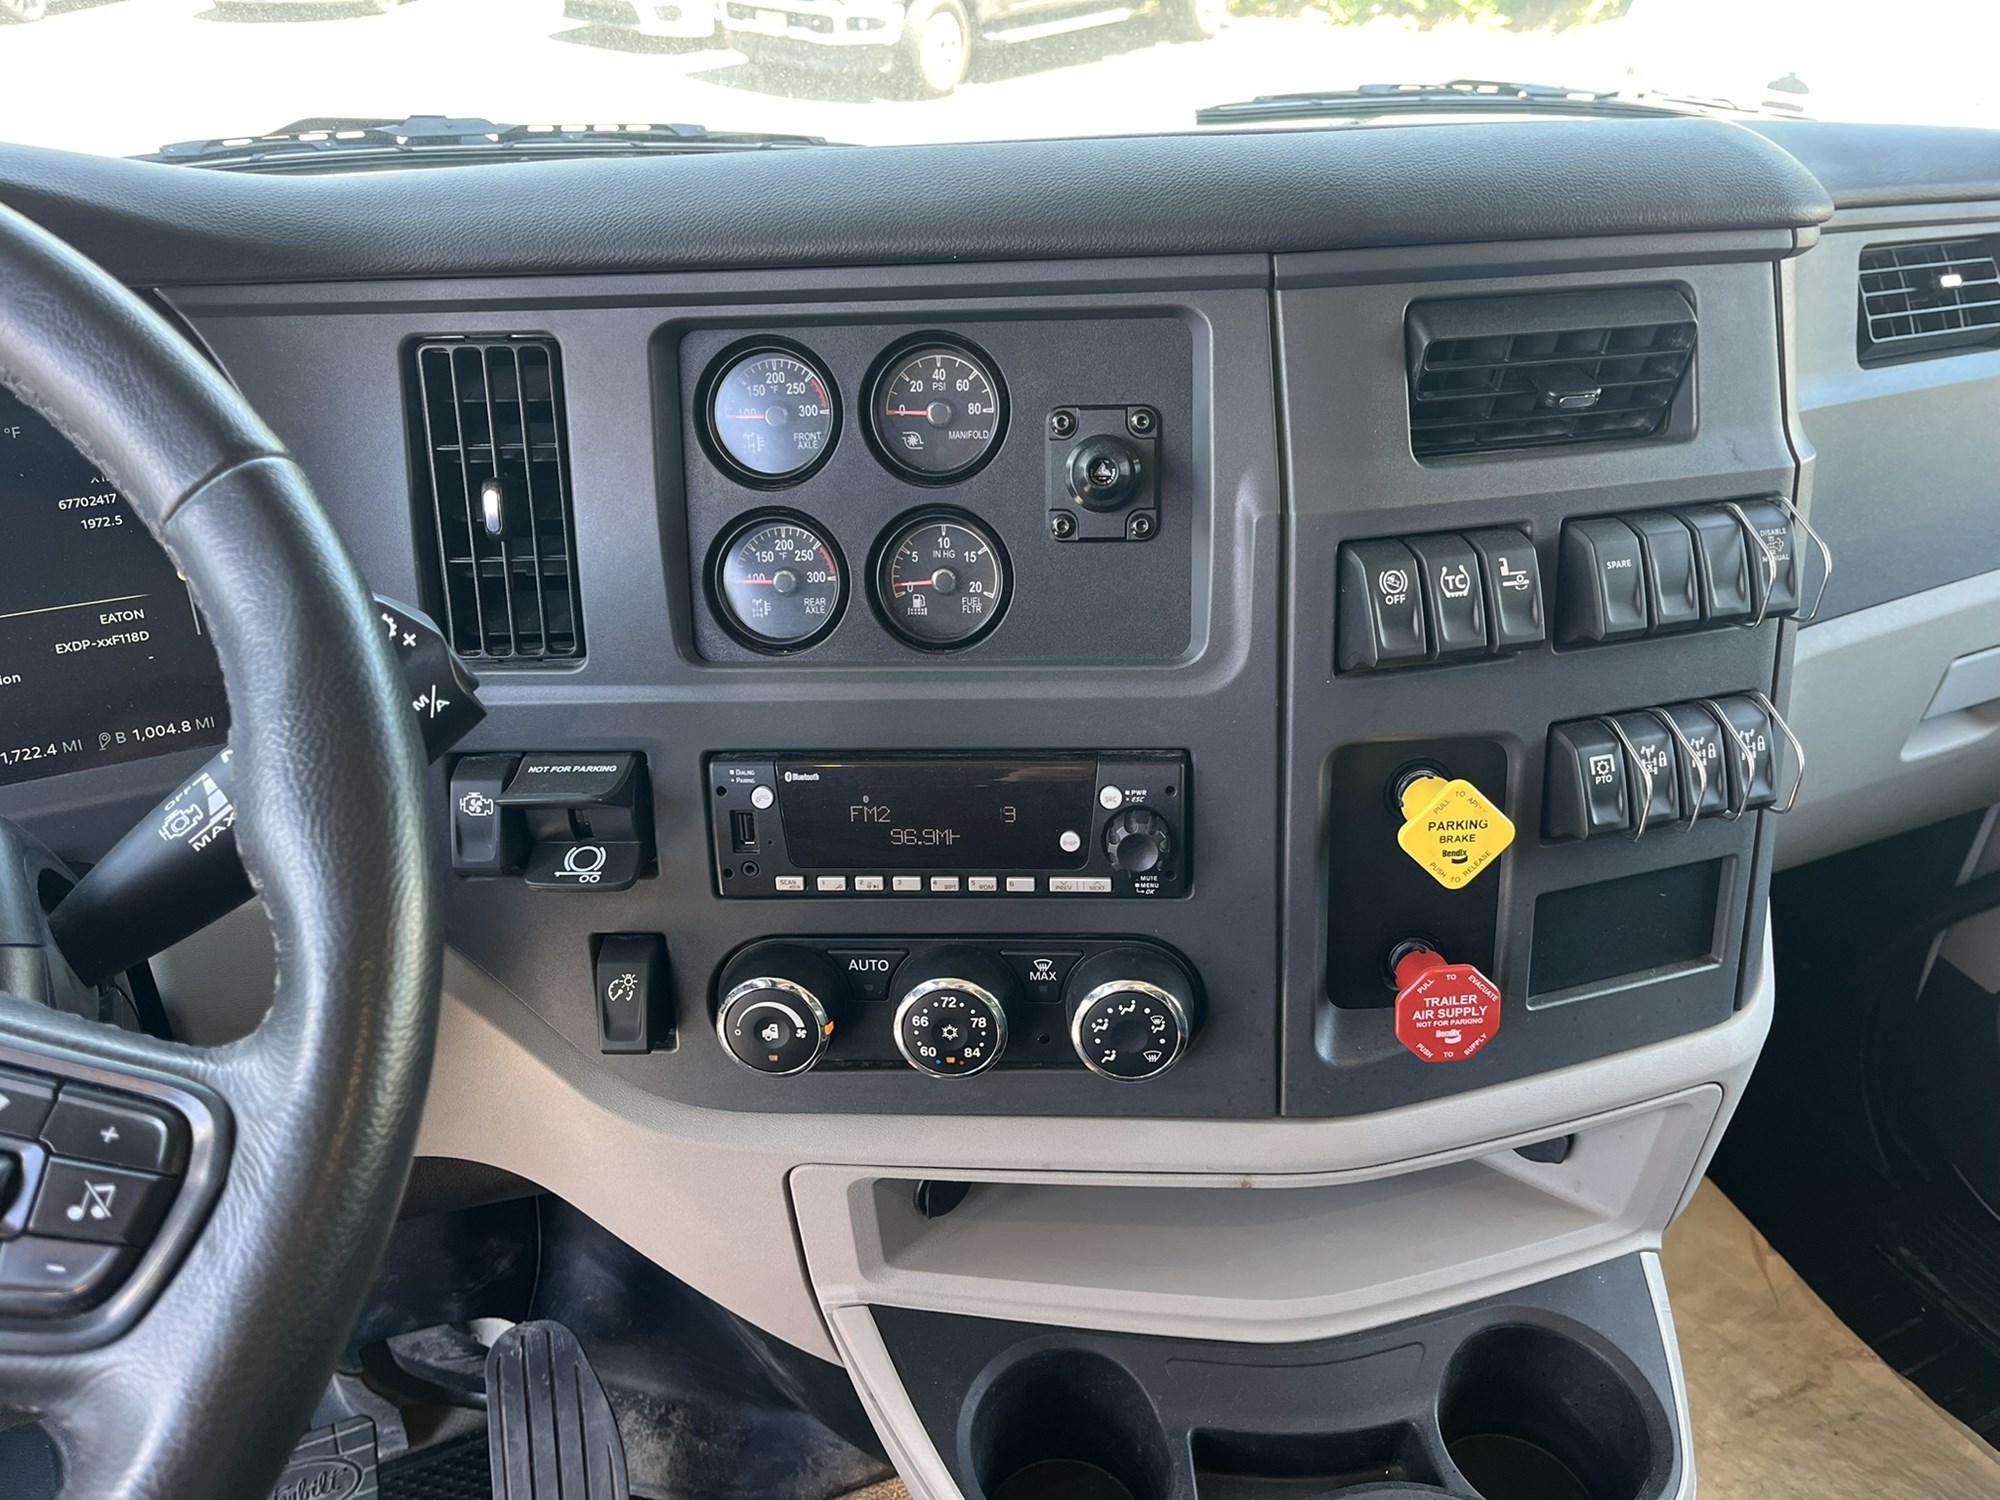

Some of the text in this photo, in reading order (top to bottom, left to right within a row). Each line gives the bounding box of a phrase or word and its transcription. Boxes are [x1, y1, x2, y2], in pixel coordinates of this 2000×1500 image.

[766, 372, 785, 384] 200
[932, 369, 945, 380] 40
[747, 385, 765, 396] 150
[786, 383, 805, 394] 250
[910, 381, 923, 392] 20
[933, 382, 946, 391] PSI
[956, 380, 969, 391] 60
[799, 405, 818, 416] 300
[968, 403, 980, 414] 80
[4, 426, 20, 438] °F
[794, 432, 821, 440] FRONT
[949, 430, 988, 439] MANIFOLD
[798, 441, 818, 449] AXLE
[58, 493, 116, 510] 67702417
[81, 515, 122, 529] 1972.5
[775, 539, 793, 550] 200
[938, 537, 950, 548] 10
[756, 551, 774, 562] 150
[795, 550, 813, 561] 250
[912, 551, 918, 562] 5
[933, 550, 955, 558] IN HG
[964, 551, 976, 562] 15
[1762, 554, 1790, 562] MNUAL
[1606, 559, 1632, 570] SPARE
[807, 571, 826, 583] 300
[1445, 574, 1466, 589] TC
[969, 581, 982, 592] 20
[804, 598, 826, 606] REAR
[962, 597, 982, 605] FUEL
[1385, 594, 1406, 605] OFF
[805, 606, 825, 614] AXLE
[100, 609, 145, 625] EATON
[55, 631, 150, 654] EXDP-xxF118D
[116, 716, 215, 744] B 1,004.8 MI
[0, 739, 82, 765] 1,722.4 MI
[572, 765, 617, 773] PARKING
[793, 772, 819, 781] Bluetooth
[1596, 774, 1612, 784] PTO
[1434, 799, 1451, 815] PULL
[850, 806, 891, 822] FM2
[1428, 820, 1488, 832] PARKING
[192, 812, 235, 852] MAX
[1440, 834, 1476, 843] BRAKE
[1442, 849, 1467, 857] Bendix
[1430, 862, 1447, 878] PUSH
[1463, 850, 1492, 876] RELEASE
[849, 960, 889, 971] AUTO
[1030, 972, 1056, 981] MAX
[1417, 979, 1435, 994] PULL
[1468, 975, 1498, 1002] EVACUATE
[941, 997, 956, 1008] 72
[1424, 995, 1477, 1007] TRAILER
[1412, 1006, 1488, 1020] AIR SUPPLY
[912, 1016, 929, 1027] 66
[971, 1017, 987, 1028] 78
[1416, 1043, 1433, 1058] PUSH
[1464, 1033, 1487, 1055] SUPPLY
[920, 1047, 937, 1057] 60
[964, 1047, 980, 1058] 84
